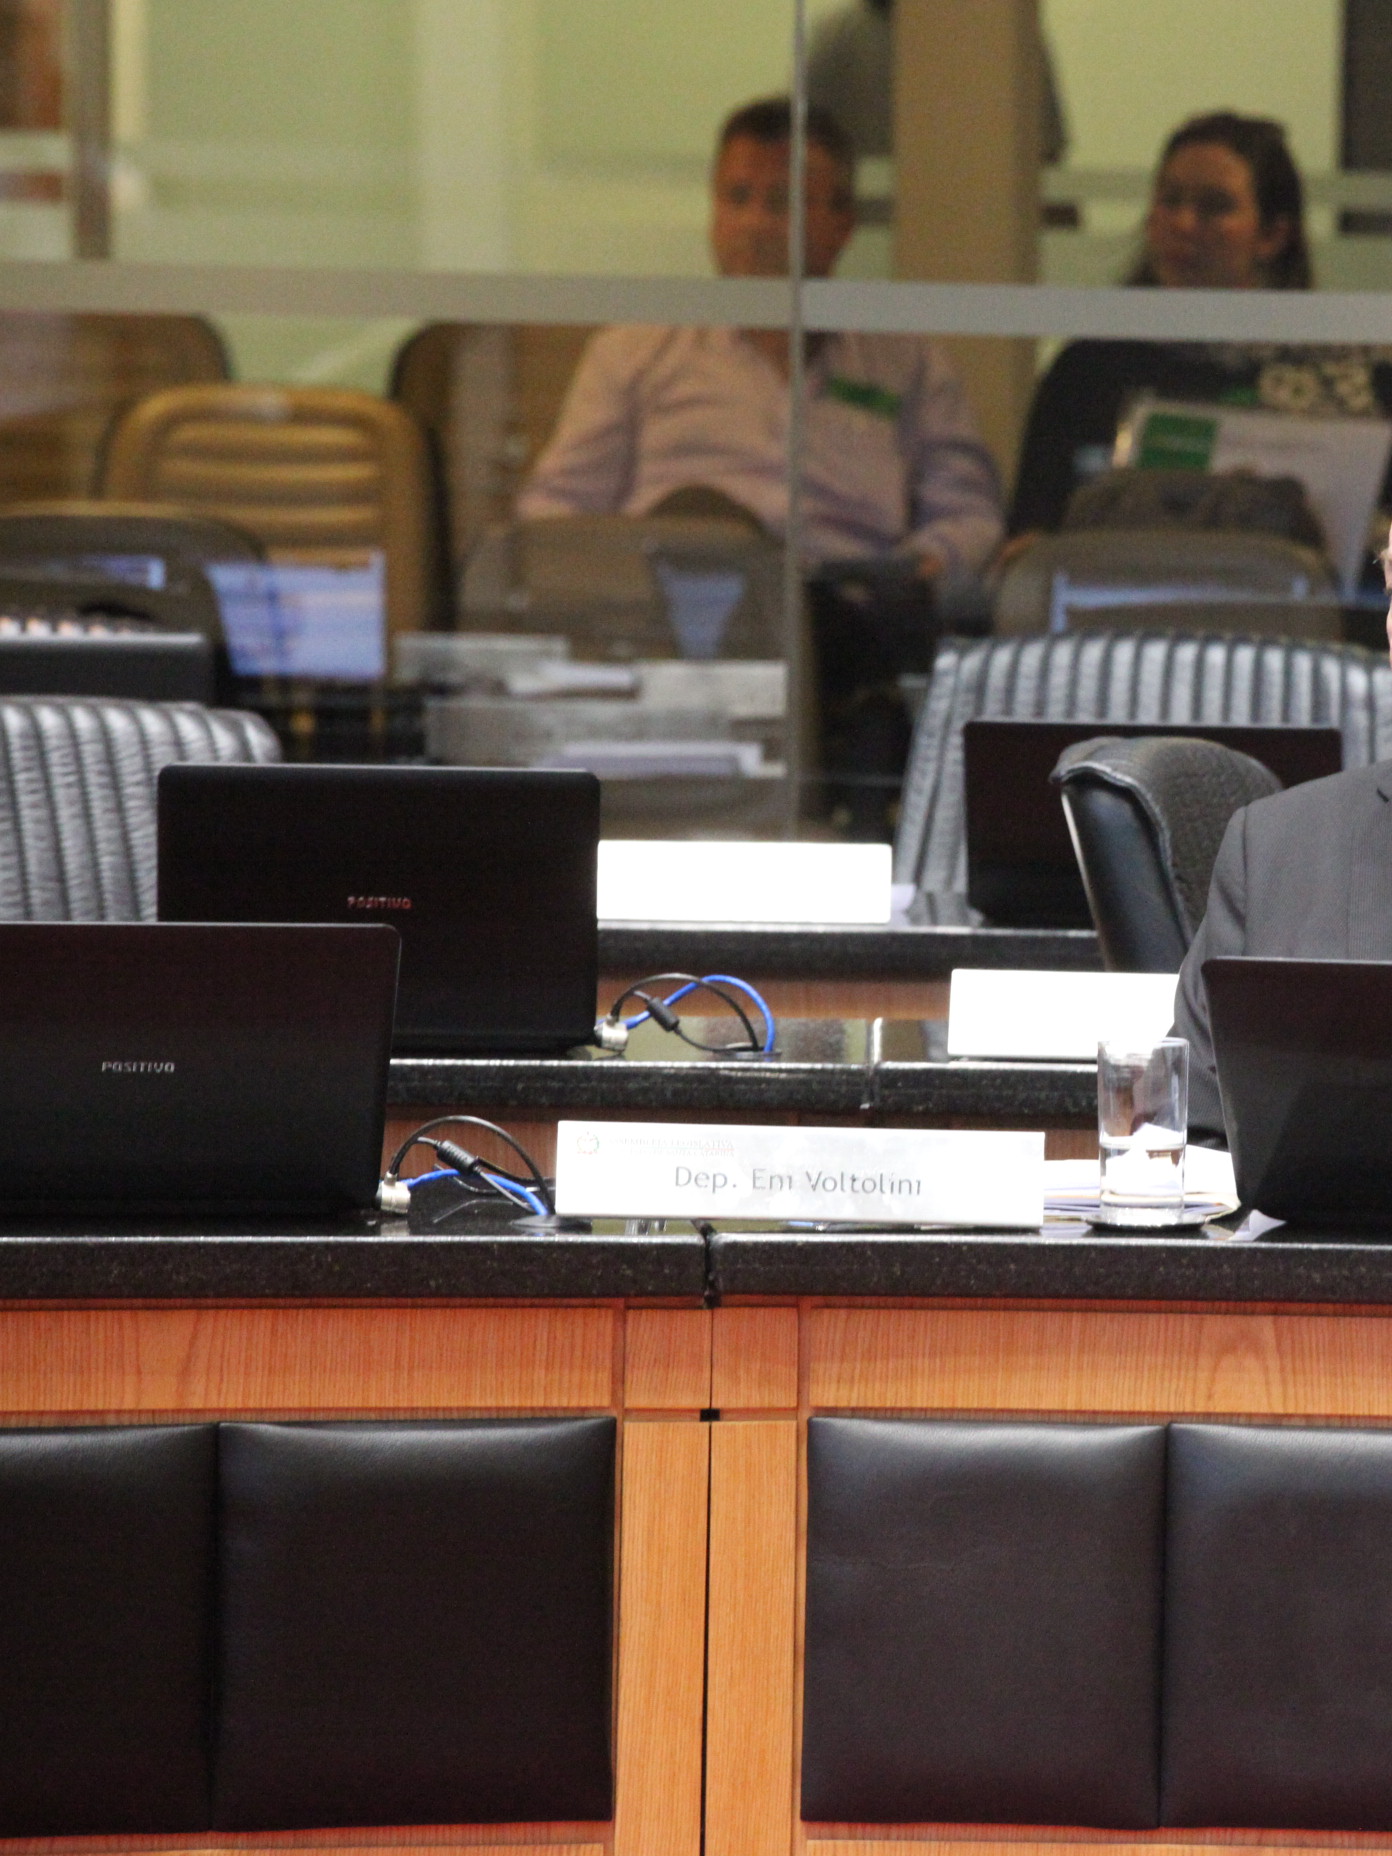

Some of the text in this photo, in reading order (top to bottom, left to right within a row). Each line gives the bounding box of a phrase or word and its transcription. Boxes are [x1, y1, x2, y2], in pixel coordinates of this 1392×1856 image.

[101, 1061, 175, 1073] POSITIVO
[674, 1165, 738, 1194] Dep.
[805, 1170, 922, 1196] Voltolini
